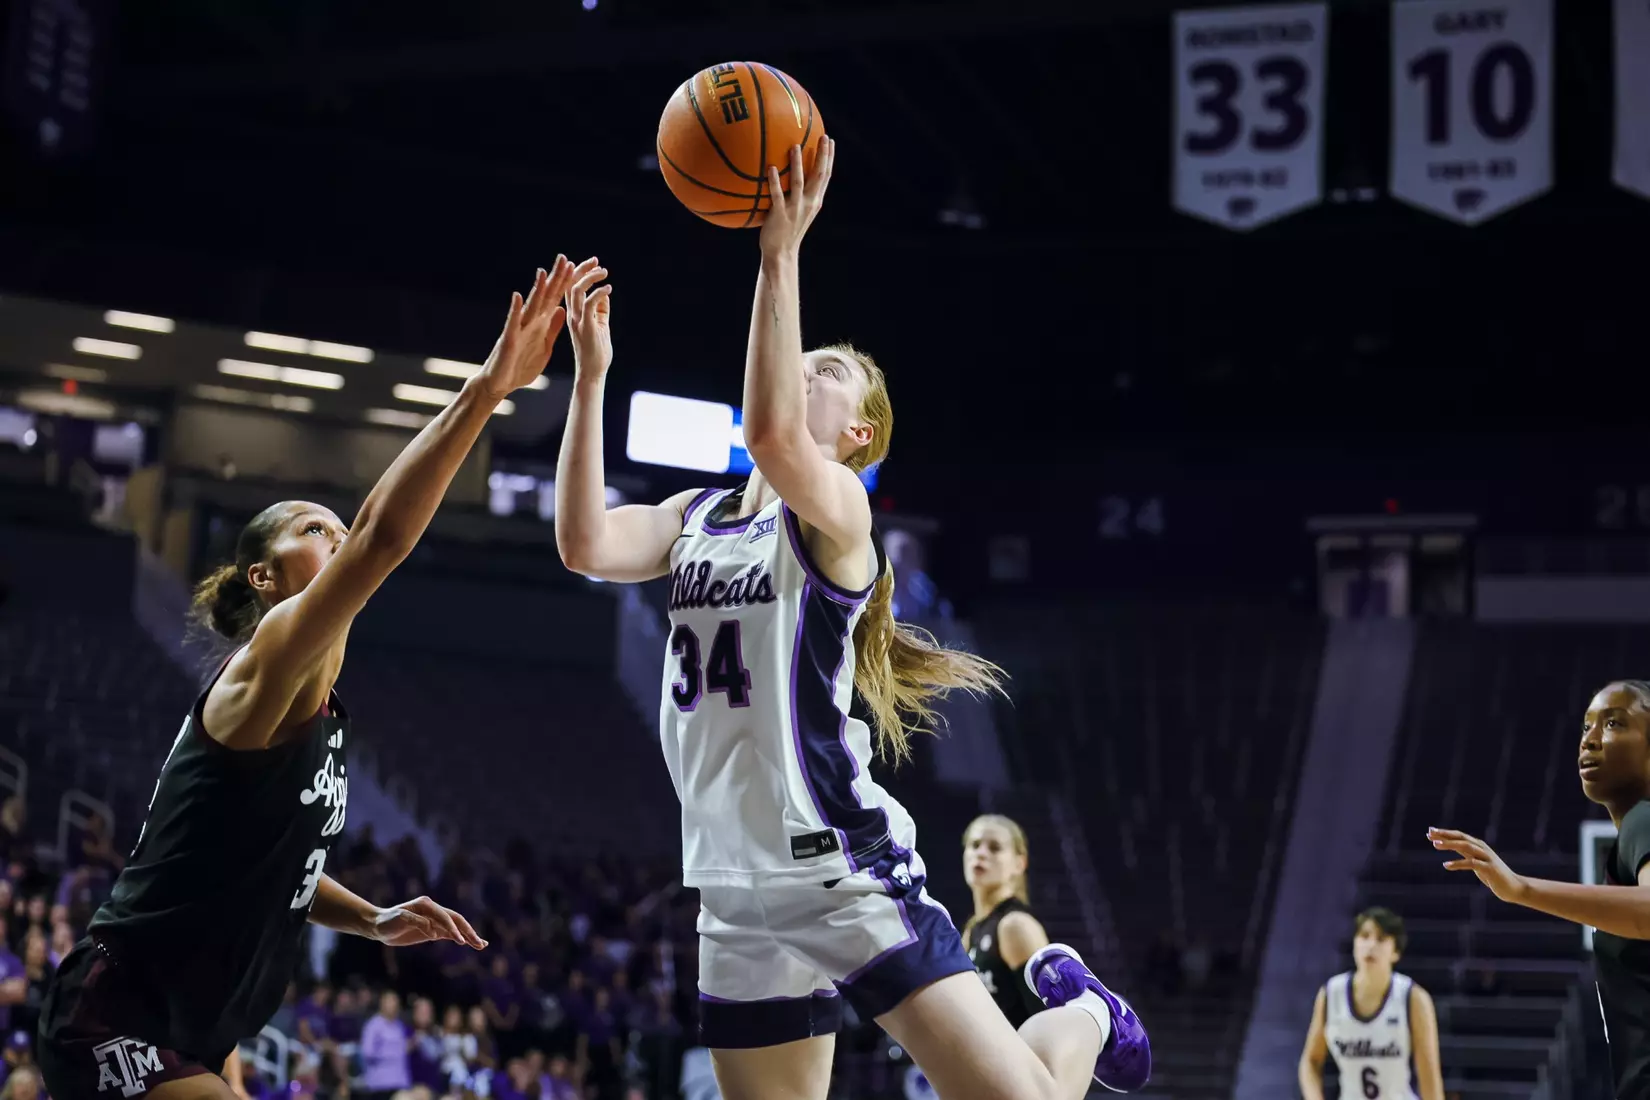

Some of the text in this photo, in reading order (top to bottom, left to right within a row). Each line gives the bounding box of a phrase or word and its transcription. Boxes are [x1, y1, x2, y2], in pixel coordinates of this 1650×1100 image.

[1434, 9, 1507, 35] GARY
[1186, 58, 1310, 153] 33
[1408, 45, 1537, 144] 10
[1097, 494, 1165, 539] 24
[671, 619, 752, 713] 34
[820, 836, 831, 848] M
[290, 846, 331, 913] 3
[1361, 1066, 1380, 1099] 6
